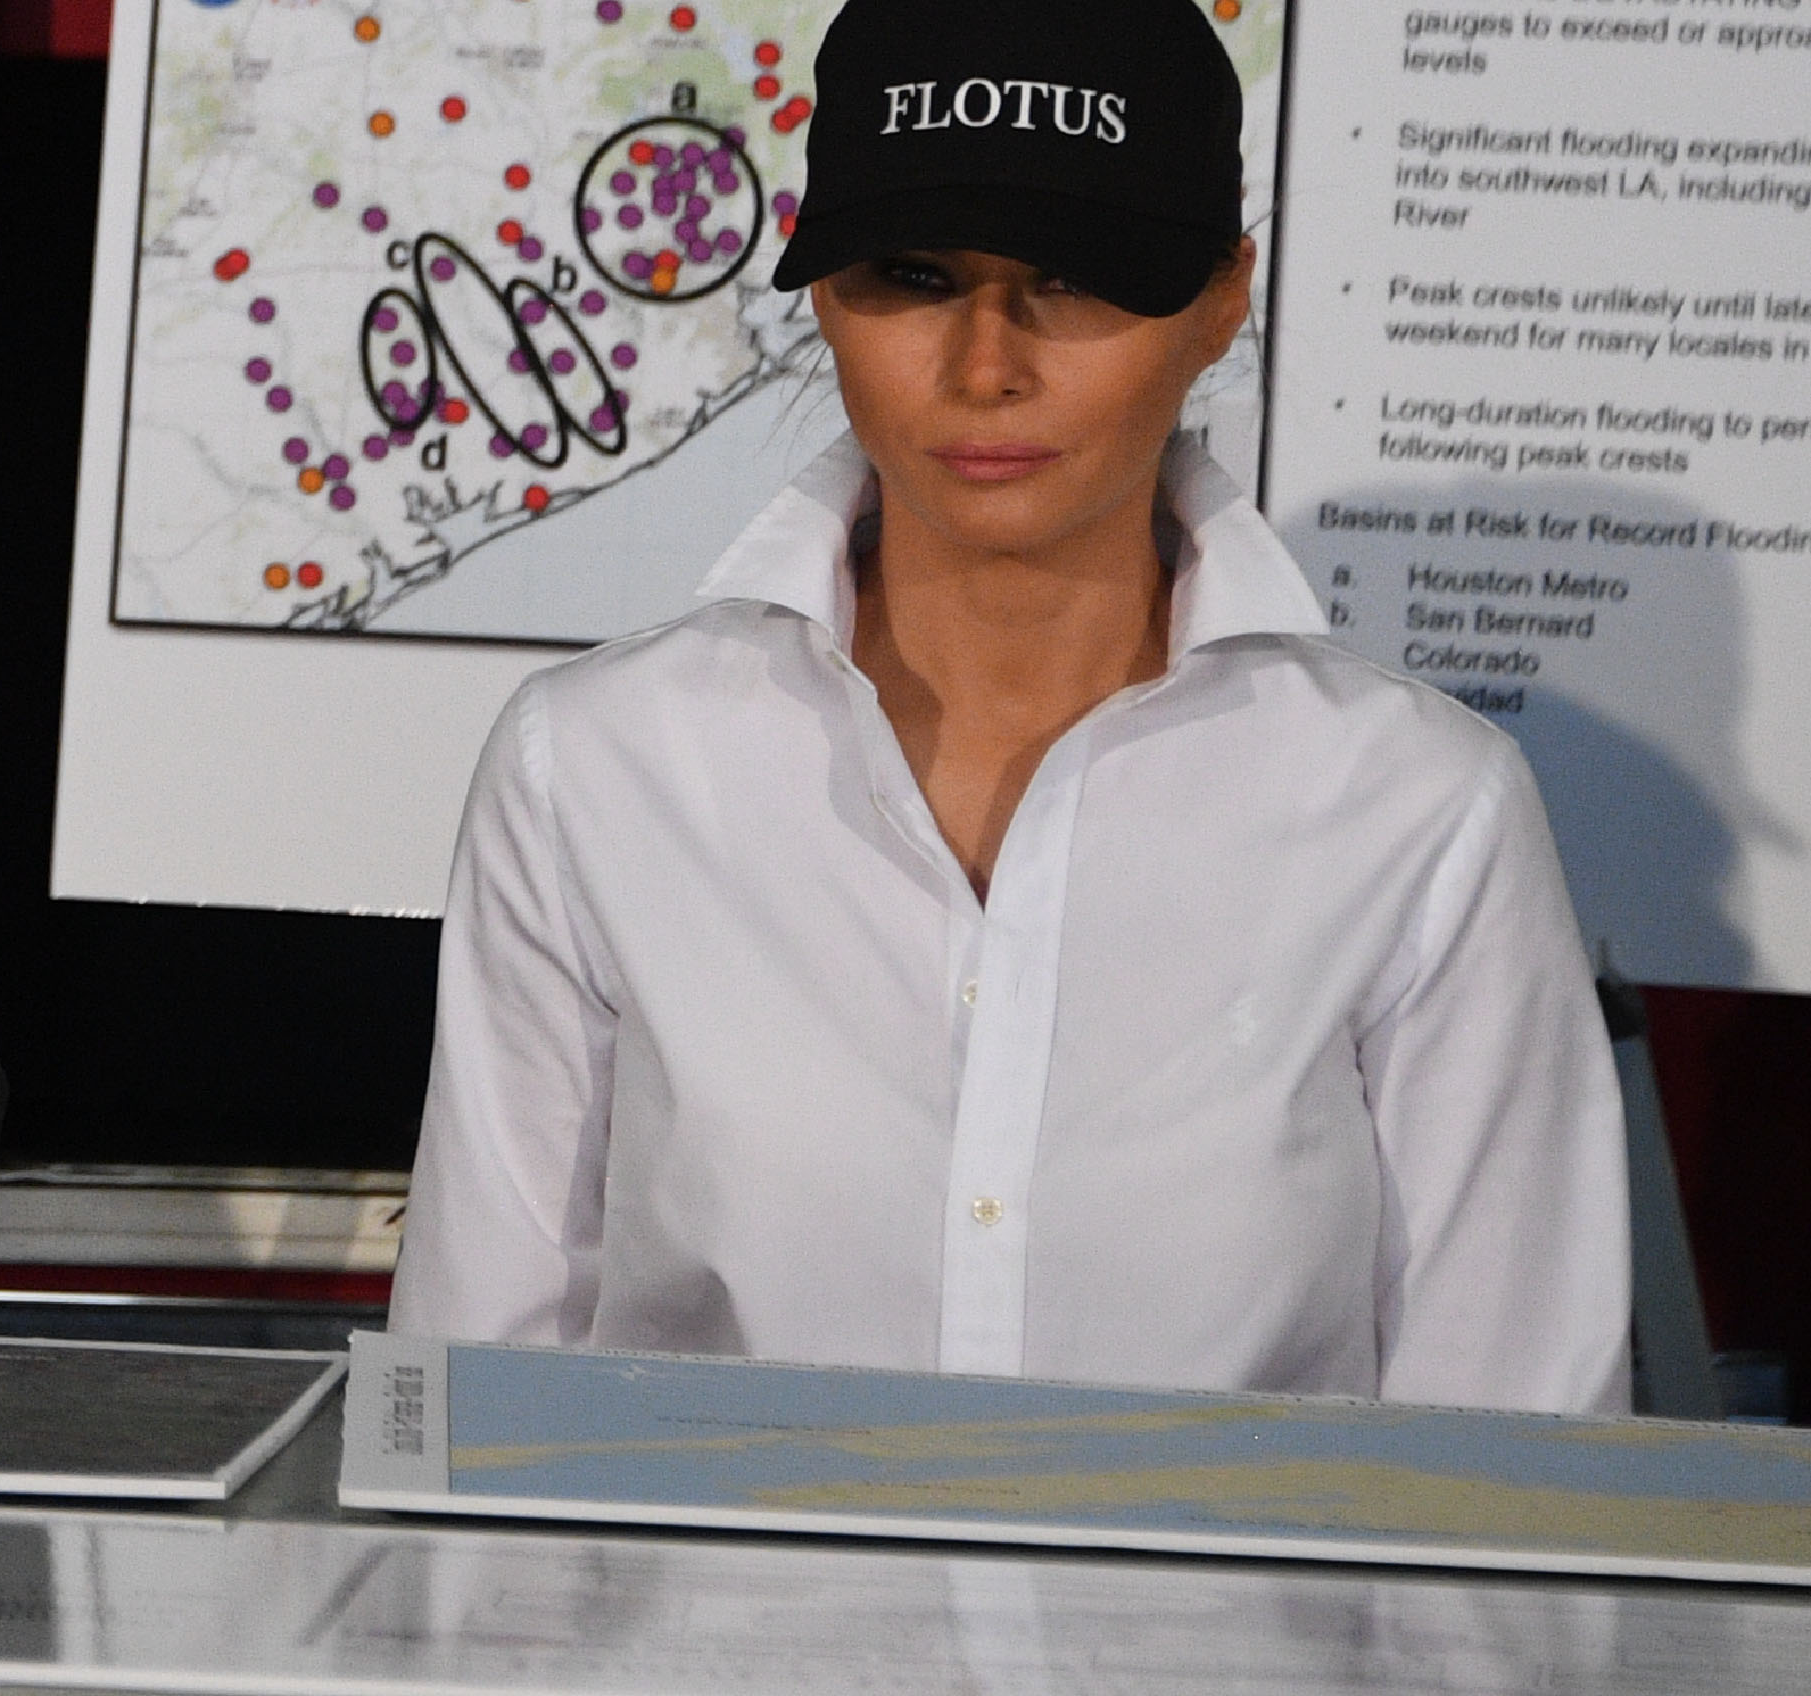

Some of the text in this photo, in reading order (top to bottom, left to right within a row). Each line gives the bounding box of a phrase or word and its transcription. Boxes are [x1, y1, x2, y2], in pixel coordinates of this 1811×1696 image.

[1405, 10, 1514, 38] gauges
[1524, 11, 1550, 39] to
[1561, 15, 1669, 45] exceed
[1678, 20, 1707, 46] or
[1404, 46, 1488, 75] levels
[671, 82, 697, 115] a
[879, 77, 1127, 144] FLOTUS
[1398, 119, 1811, 168] Significant flooding expandi
[1396, 158, 1448, 190] into
[1458, 164, 1608, 197] southwest
[1678, 172, 1811, 212] including
[1394, 197, 1469, 230] River
[386, 241, 413, 270] c
[551, 252, 578, 293] b
[1388, 273, 1463, 306] Peak
[1472, 282, 1562, 314] crests
[1572, 283, 1685, 324] unlikely
[1694, 288, 1756, 321] until
[1385, 318, 1519, 350] weekend
[1529, 321, 1567, 351] for
[1577, 327, 1661, 362] many
[1669, 326, 1773, 360] locales
[1380, 393, 1587, 430] Long-duration
[1596, 400, 1714, 442] flooding
[1724, 406, 1753, 439] to
[421, 432, 447, 471] d
[1378, 431, 1690, 474] following peak crests
[1317, 501, 1417, 535] Basins
[1427, 509, 1455, 535] at
[1464, 507, 1529, 540] Risk
[1538, 511, 1578, 541] for
[1588, 513, 1696, 548] Record
[1407, 561, 1533, 597] Houston
[1542, 568, 1630, 601] Metro
[1405, 600, 1465, 633] San
[1474, 604, 1595, 639] Bernard
[1403, 638, 1540, 677] Colorado
